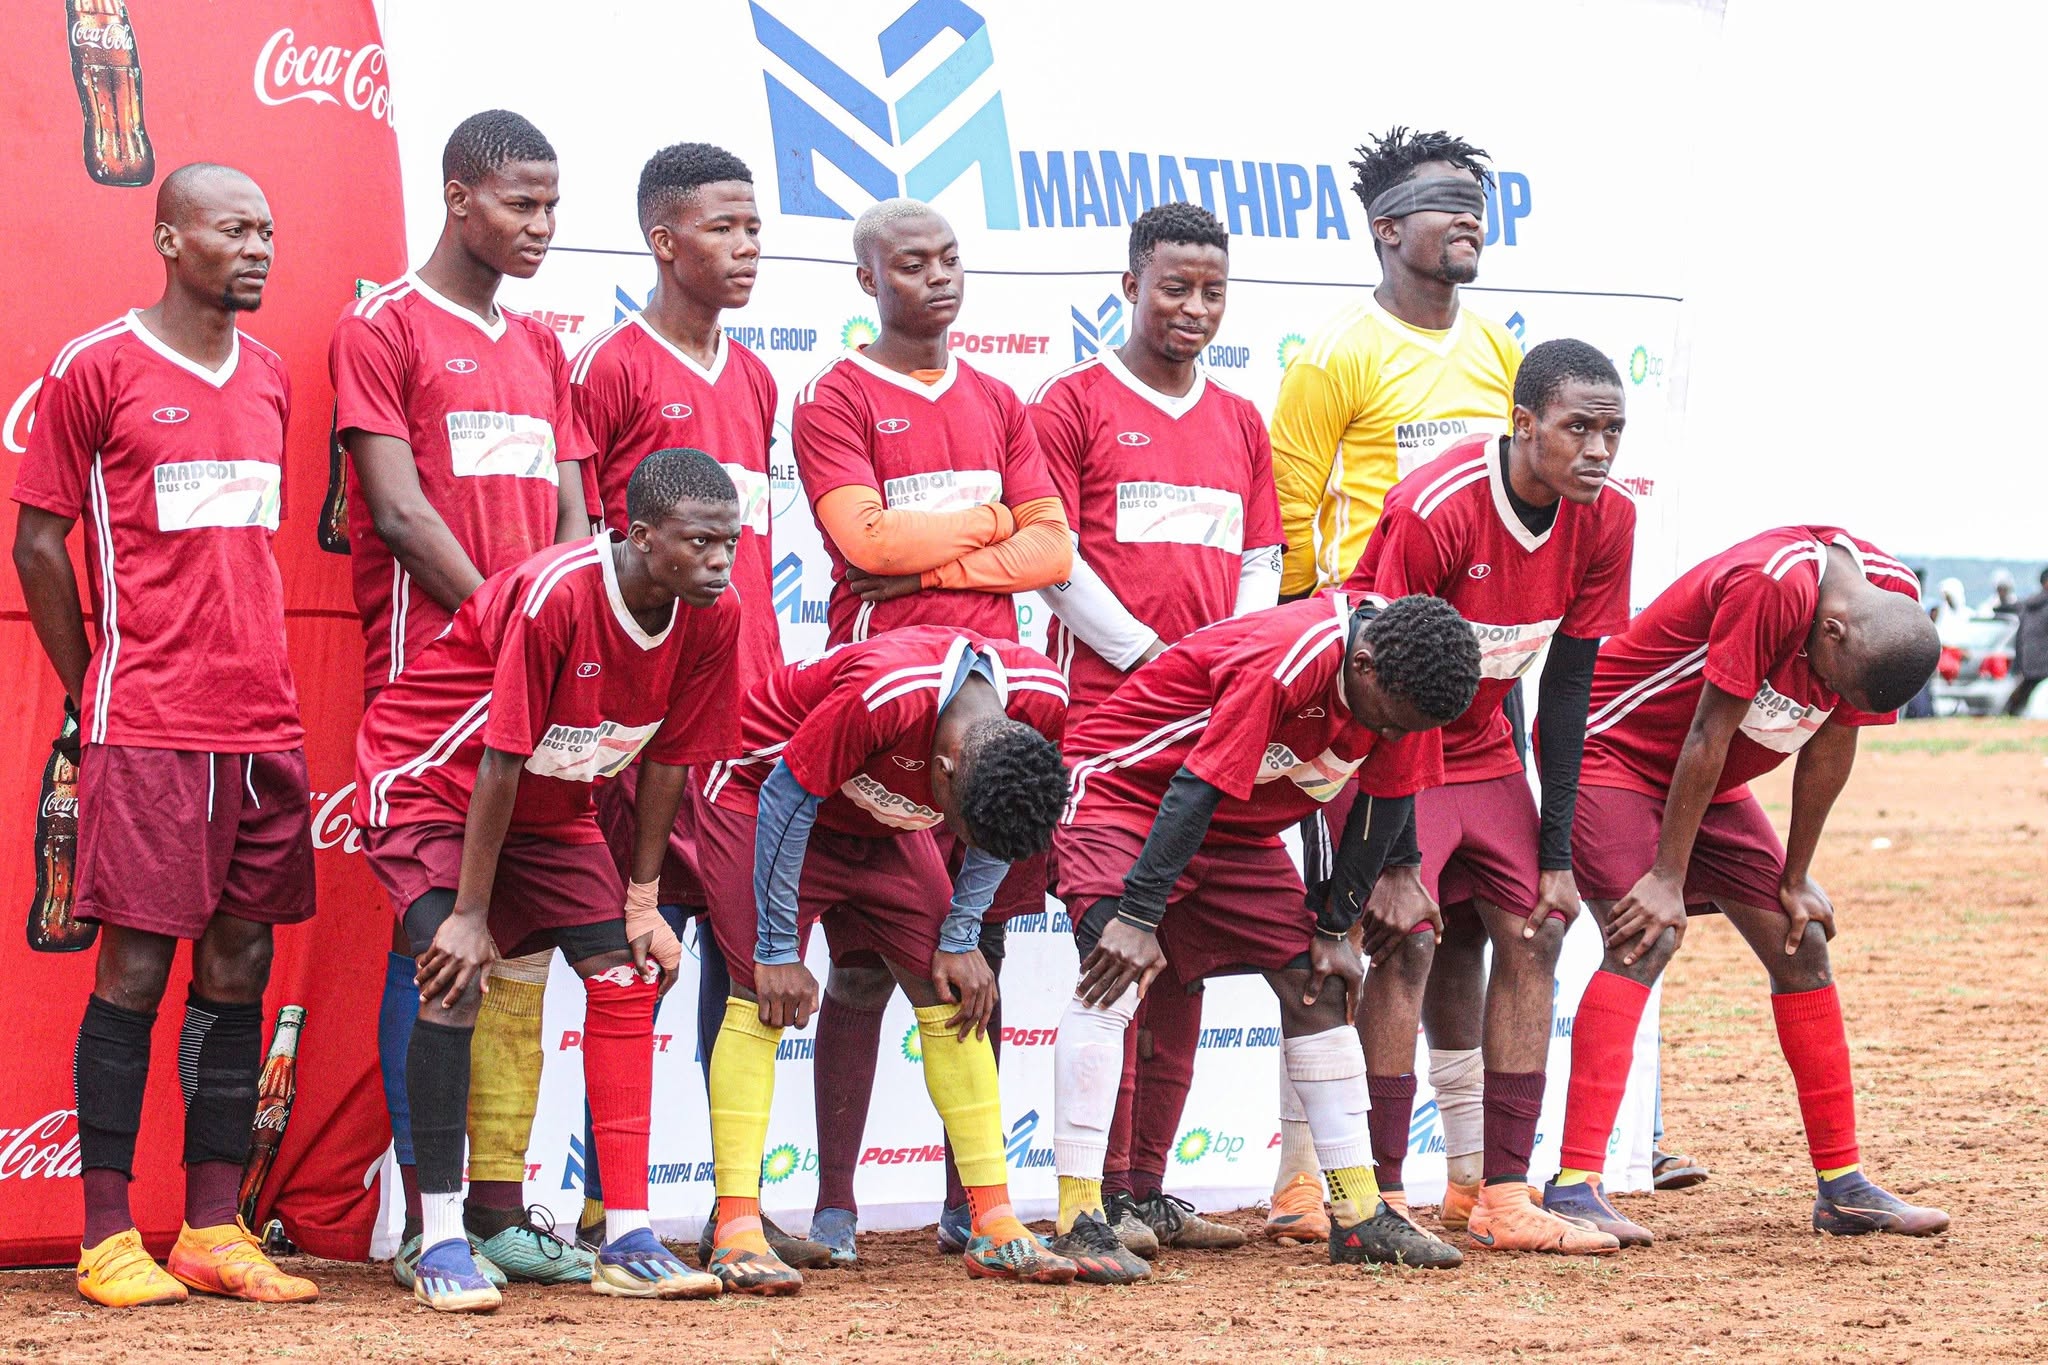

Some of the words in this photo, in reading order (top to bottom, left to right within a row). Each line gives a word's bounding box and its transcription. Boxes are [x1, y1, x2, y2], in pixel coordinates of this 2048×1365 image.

[1019, 151, 1350, 241] MAMATHIPA
[770, 327, 817, 351] GROUP
[1208, 344, 1250, 369] GROUP
[1397, 420, 1468, 440] MADODI
[1398, 440, 1419, 448] BUS
[1422, 438, 1435, 447] CO
[157, 462, 237, 483] MADODI
[158, 483, 180, 493] BUS
[184, 481, 200, 490] CO
[1119, 484, 1196, 502] MADODI
[1119, 500, 1140, 509] BUS
[1143, 500, 1158, 509] CO
[1018, 605, 1032, 631] p
[1475, 626, 1520, 642] DODI
[1754, 697, 1767, 710] US
[542, 738, 565, 750] BUS
[568, 745, 583, 753] CO
[1245, 1027, 1280, 1047] GROU
[1213, 1131, 1245, 1158] bp
